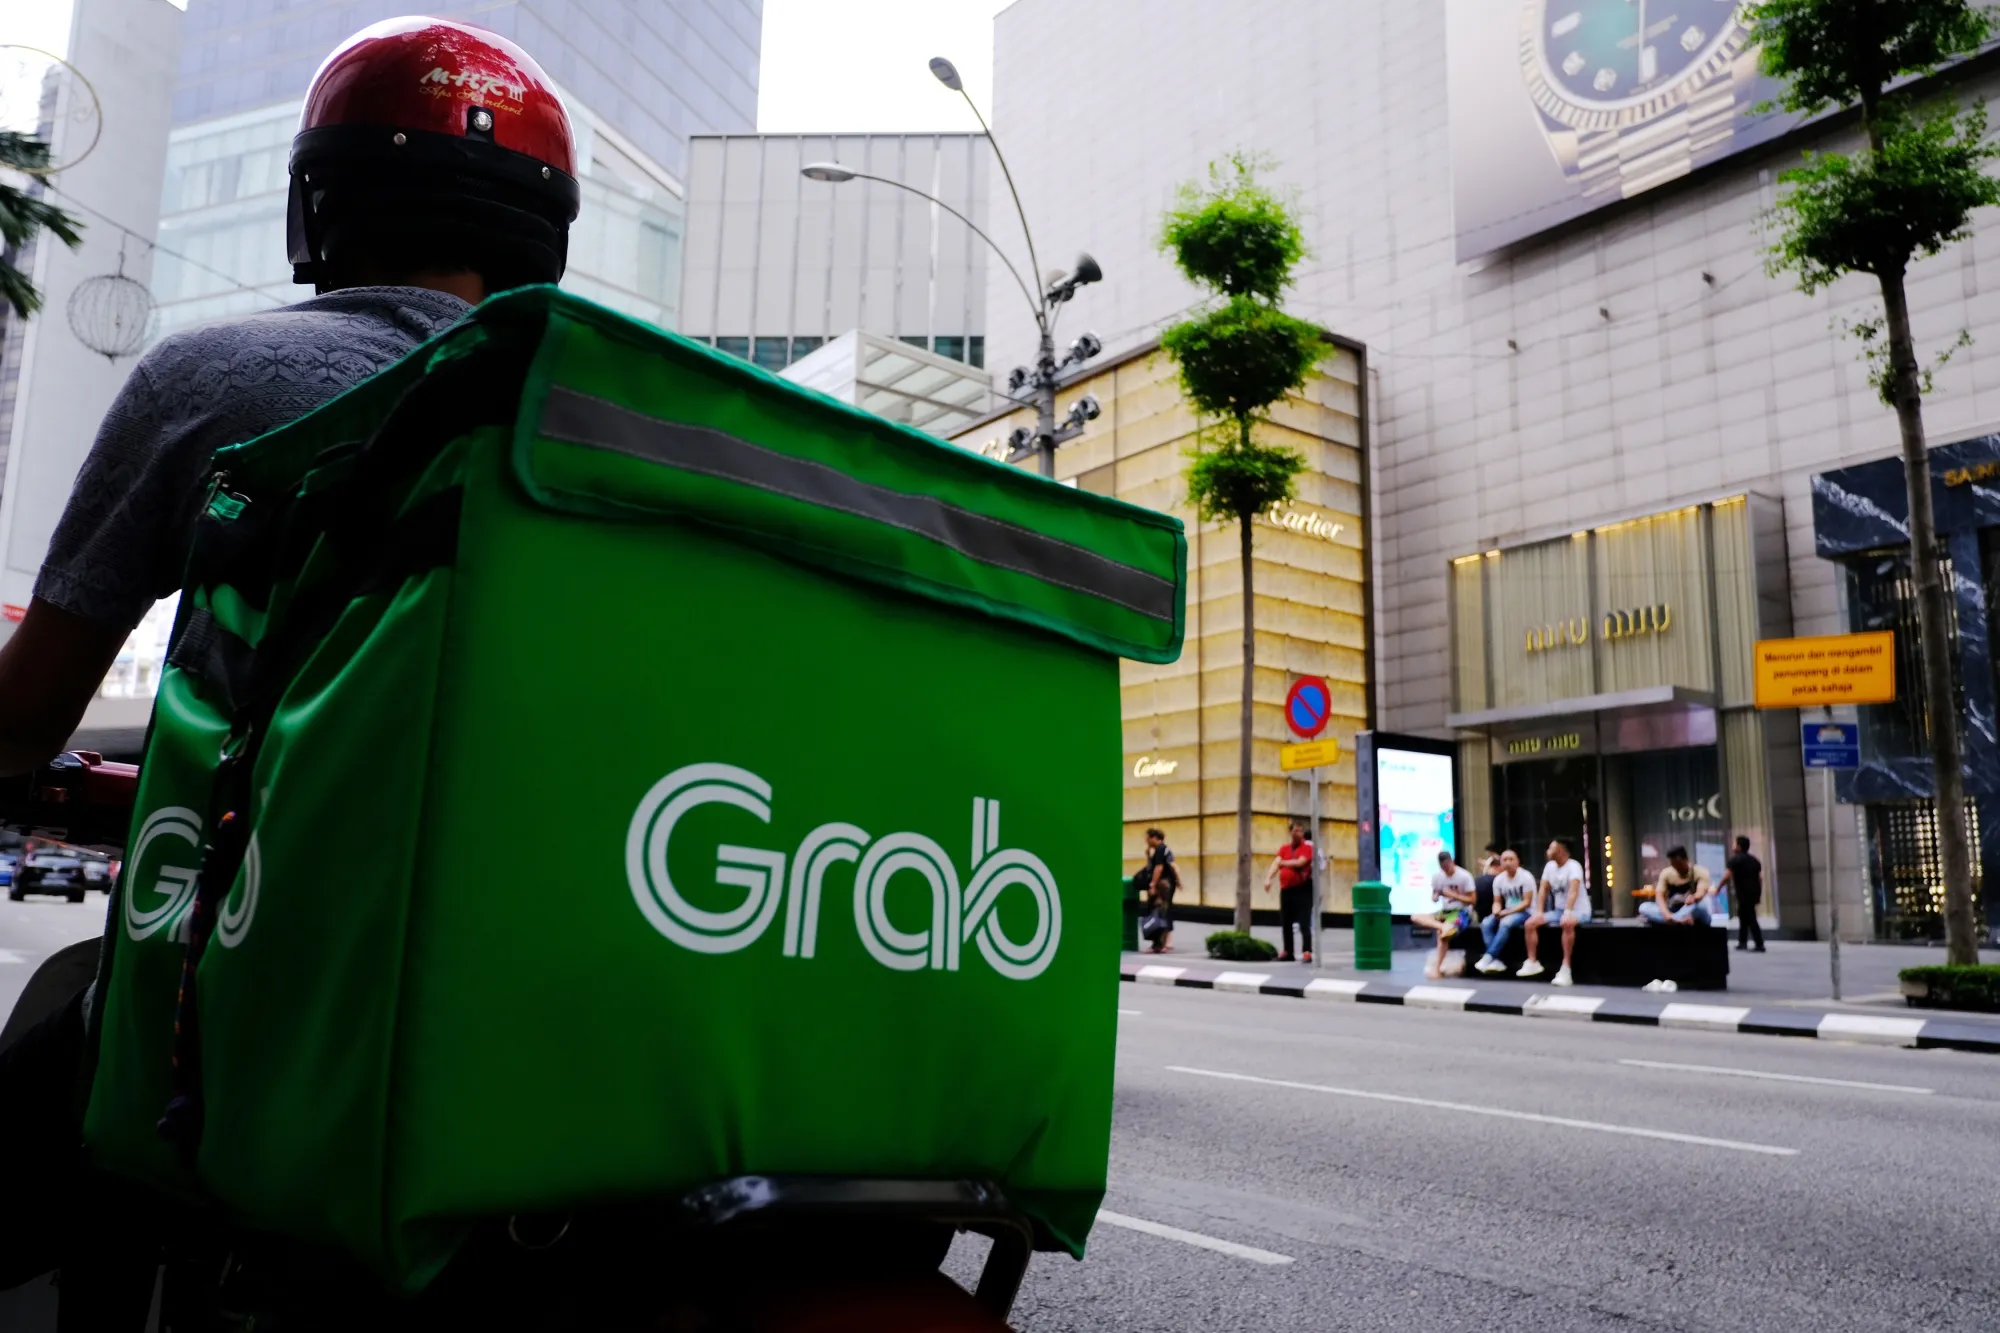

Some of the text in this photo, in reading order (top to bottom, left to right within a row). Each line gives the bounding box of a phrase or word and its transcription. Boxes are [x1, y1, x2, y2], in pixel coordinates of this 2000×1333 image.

[1269, 496, 1344, 539] Cartier
[1526, 602, 1671, 651] miu miu
[1764, 645, 1882, 663] Menurun dan mengambil
[1773, 668, 1828, 681] penumpang
[1843, 664, 1873, 674] dalam
[1792, 682, 1852, 696] petak sahaja
[1133, 756, 1178, 778] Cartier
[625, 762, 1062, 980] Grab
